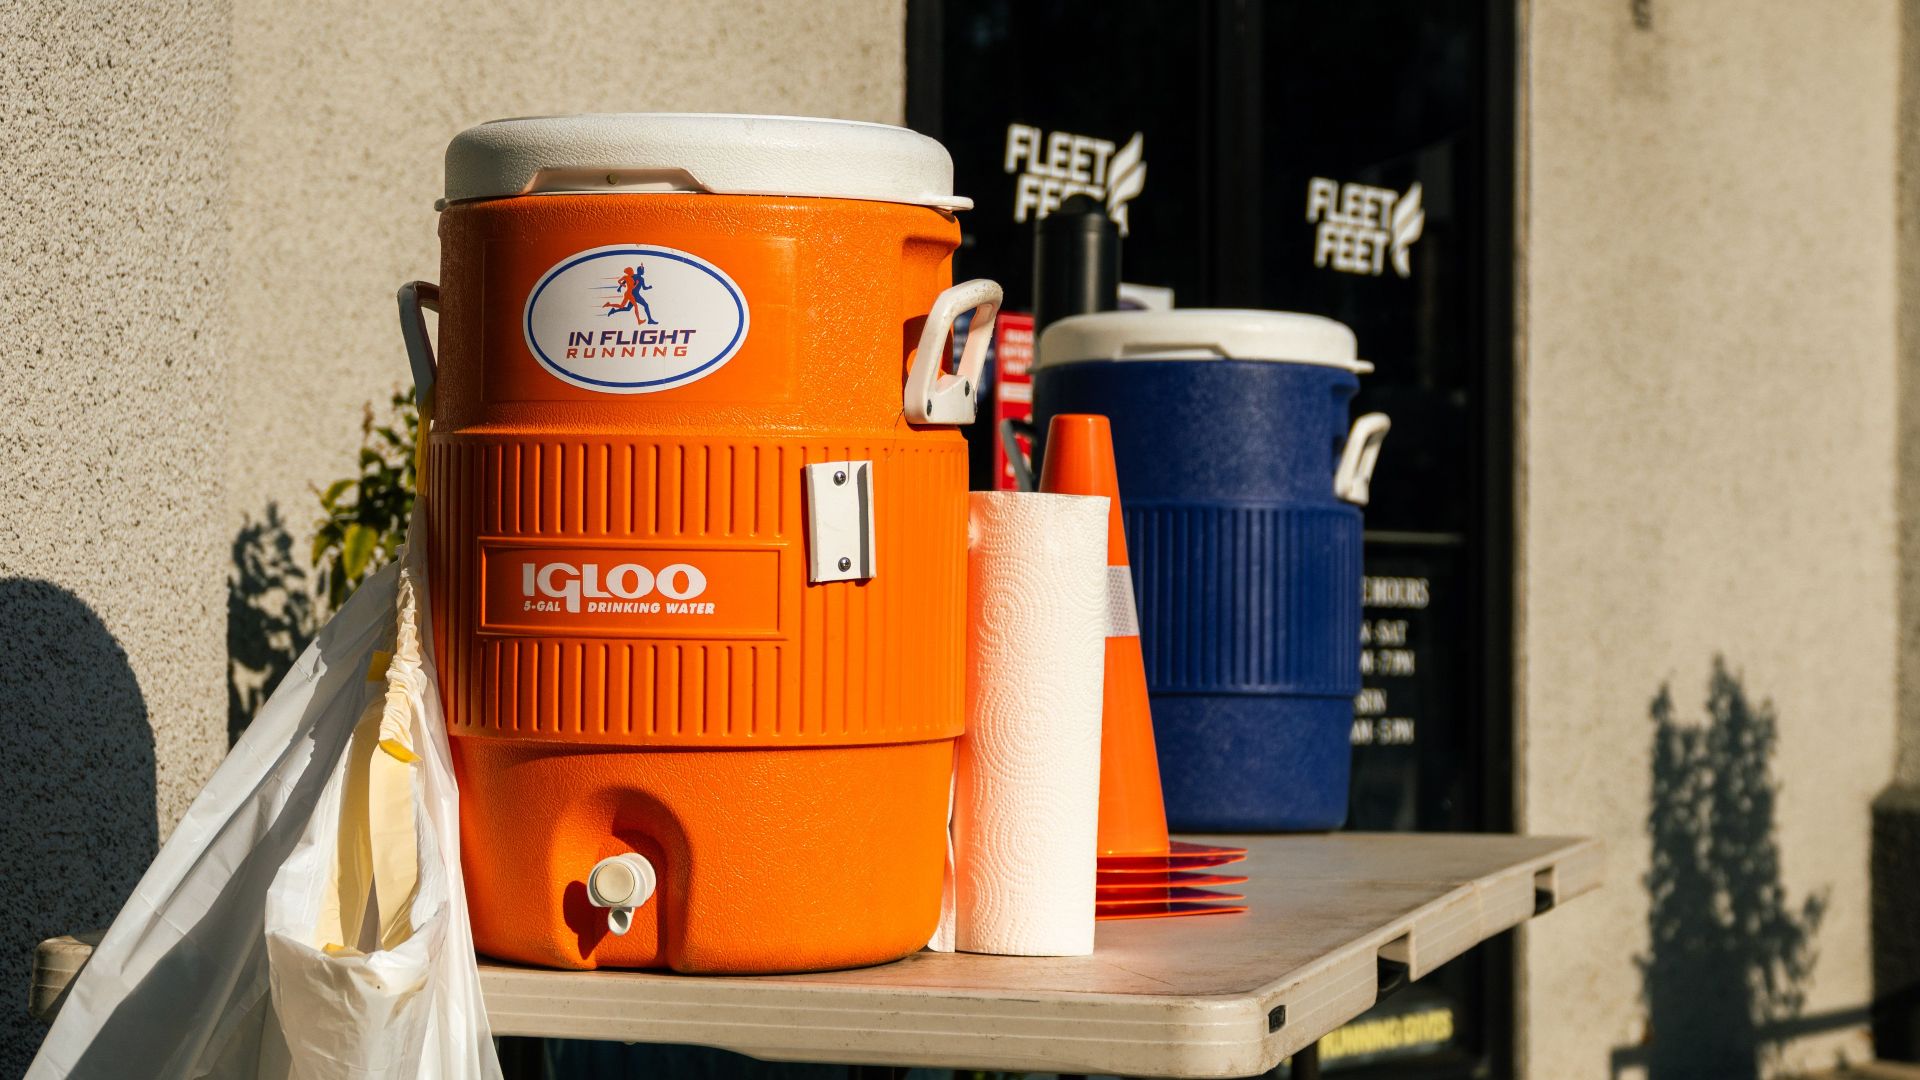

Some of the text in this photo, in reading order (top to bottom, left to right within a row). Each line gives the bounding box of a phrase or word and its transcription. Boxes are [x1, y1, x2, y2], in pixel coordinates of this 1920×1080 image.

[1004, 123, 1116, 185] FLEET
[1014, 173, 1106, 224] FE
[1305, 176, 1399, 231] FLEET
[1313, 222, 1388, 277] FEET
[566, 346, 688, 359] RUNNING
[568, 329, 696, 346] IN FLIGHT
[522, 562, 707, 613] IGLOO
[523, 601, 715, 615] 5-GAL DRINKING WATER
[1371, 576, 1429, 609] HOURS
